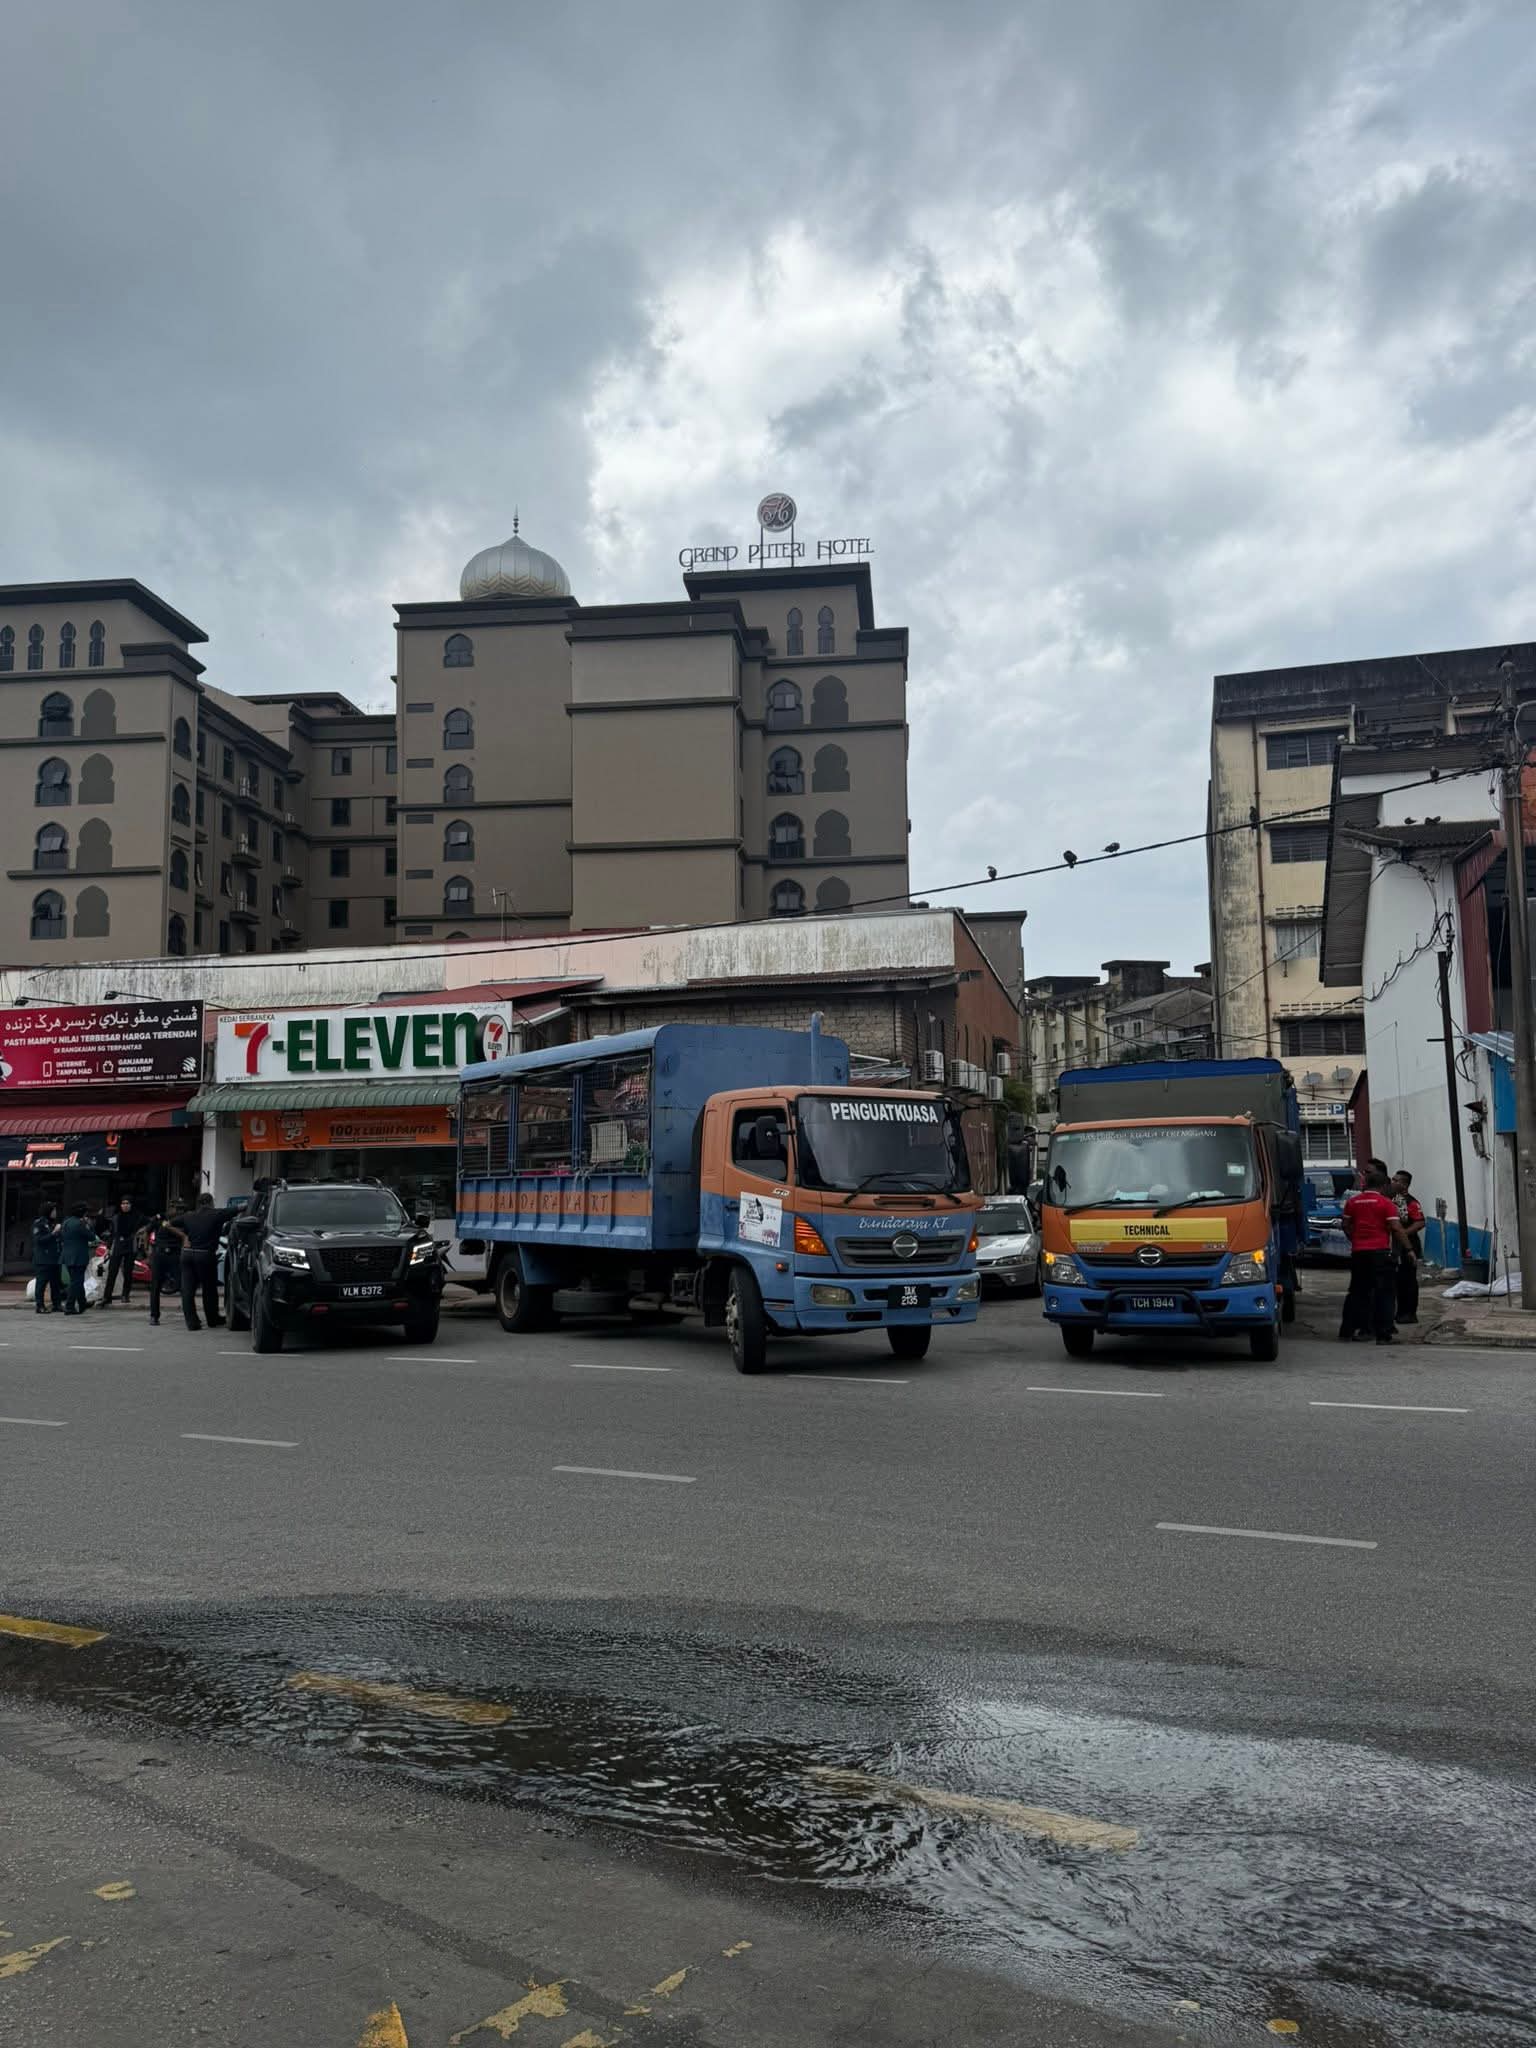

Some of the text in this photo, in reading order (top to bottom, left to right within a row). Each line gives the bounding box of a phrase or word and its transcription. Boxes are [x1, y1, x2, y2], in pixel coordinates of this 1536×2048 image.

[679, 538, 875, 572] GRAND PUTERI HOTEL
[4, 1029, 198, 1046] PASTI MAMPU NILAI TERBESAR HARGA TERENDAH
[107, 1043, 142, 1051] TERPANTAS
[56, 1060, 86, 1068] INTERNET
[117, 1057, 154, 1066] GANJARAN
[117, 1065, 152, 1074] EKSKLUSIF
[829, 1101, 939, 1123] PENGUATKUASA
[1333, 1104, 1343, 1115] P
[396, 1124, 438, 1136] PANTAS
[1124, 1224, 1170, 1236] TECHNICAL
[342, 1285, 383, 1297] VLM 6372
[900, 1295, 918, 1306] 2135
[1132, 1297, 1150, 1308] TCH
